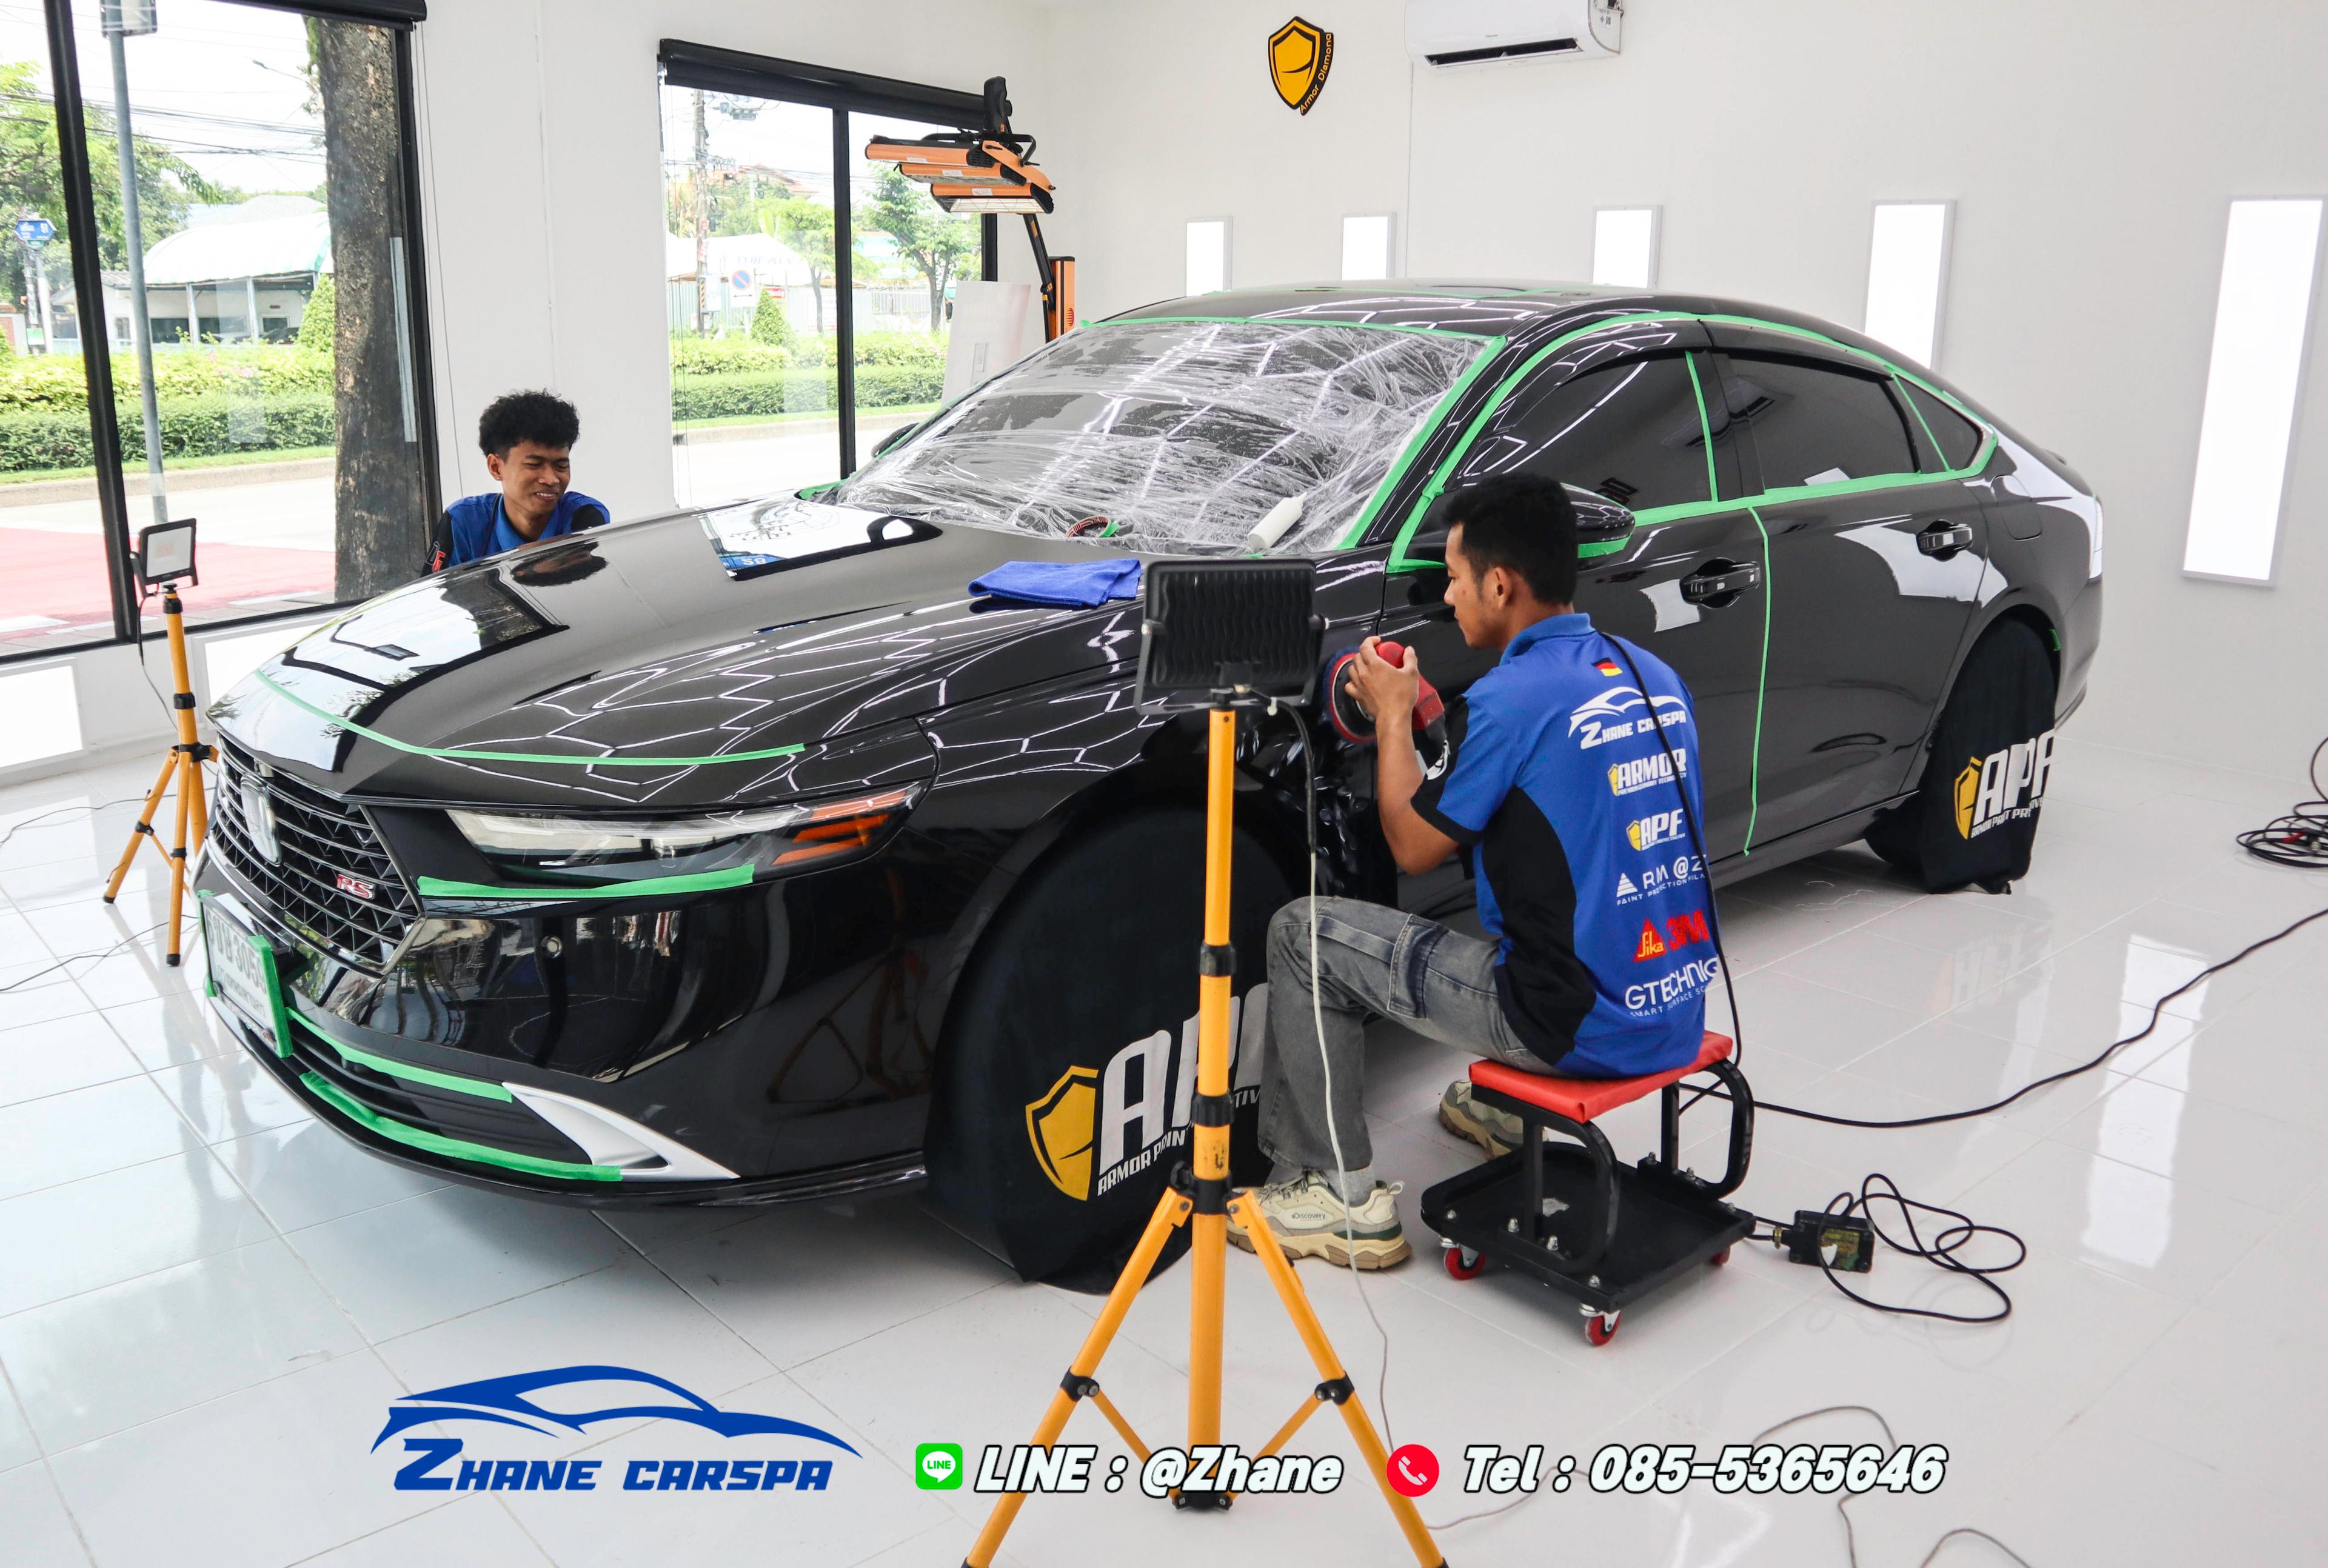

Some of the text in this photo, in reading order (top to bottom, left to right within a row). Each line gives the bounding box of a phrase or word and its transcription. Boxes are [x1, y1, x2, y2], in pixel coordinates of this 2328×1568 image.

[1300, 33, 1332, 113] Armor Diamond
[1580, 721, 1634, 749] ZHANE
[1617, 747, 1687, 789] ARMOR
[1641, 807, 1684, 846] APF
[336, 873, 375, 899] RS
[1616, 893, 1644, 907] PAINT
[1637, 909, 1710, 958] Sika 3M
[1098, 1149, 1152, 1197] ARMOR
